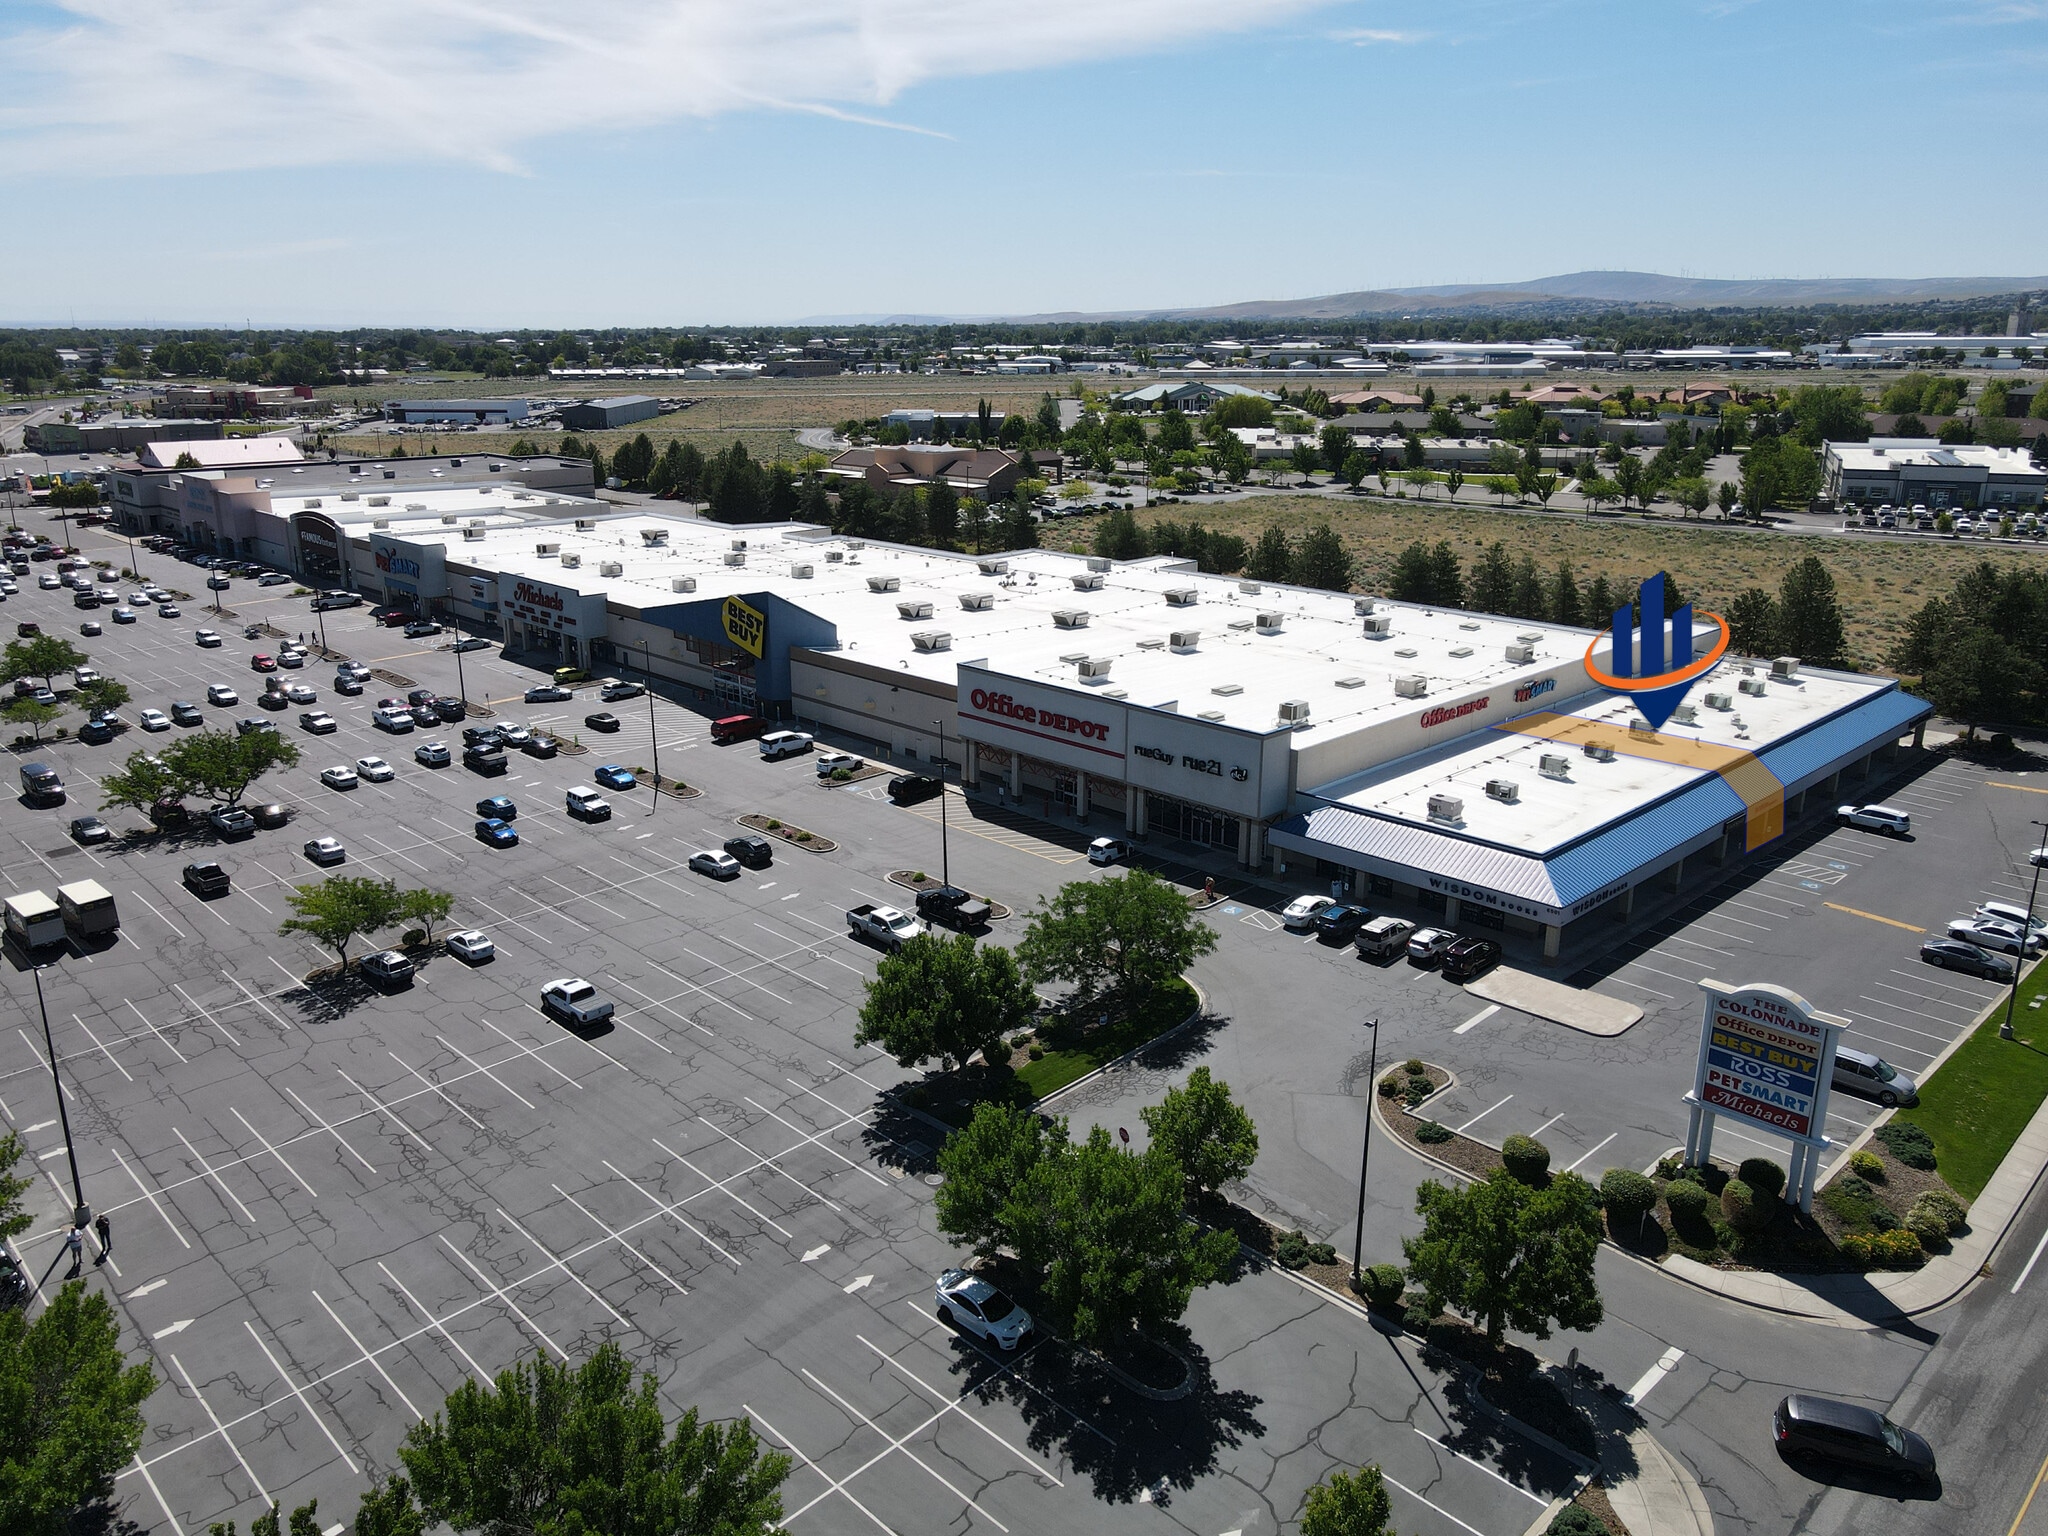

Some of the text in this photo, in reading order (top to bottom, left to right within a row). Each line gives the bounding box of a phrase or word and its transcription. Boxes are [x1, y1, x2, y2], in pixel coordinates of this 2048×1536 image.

[514, 583, 564, 611] Michaels
[728, 601, 763, 633] BEST
[728, 618, 759, 647] BUY
[970, 688, 1109, 742] Office DEPOT
[1420, 696, 1490, 728] Office DEPOT
[1133, 744, 1175, 766] rueGuy
[1182, 755, 1223, 776] rue21
[1429, 877, 1497, 905] WISDOM
[1572, 890, 1609, 916] WISDOM
[1718, 999, 1821, 1037] COLONNADE
[1752, 997, 1788, 1015] THE
[1717, 1015, 1817, 1054] Office DEPOT
[1712, 1032, 1816, 1073] BEST BUY
[1730, 1056, 1791, 1088] ROSS
[1709, 1070, 1809, 1113] PETSMART
[1711, 1091, 1800, 1129] Michaels
